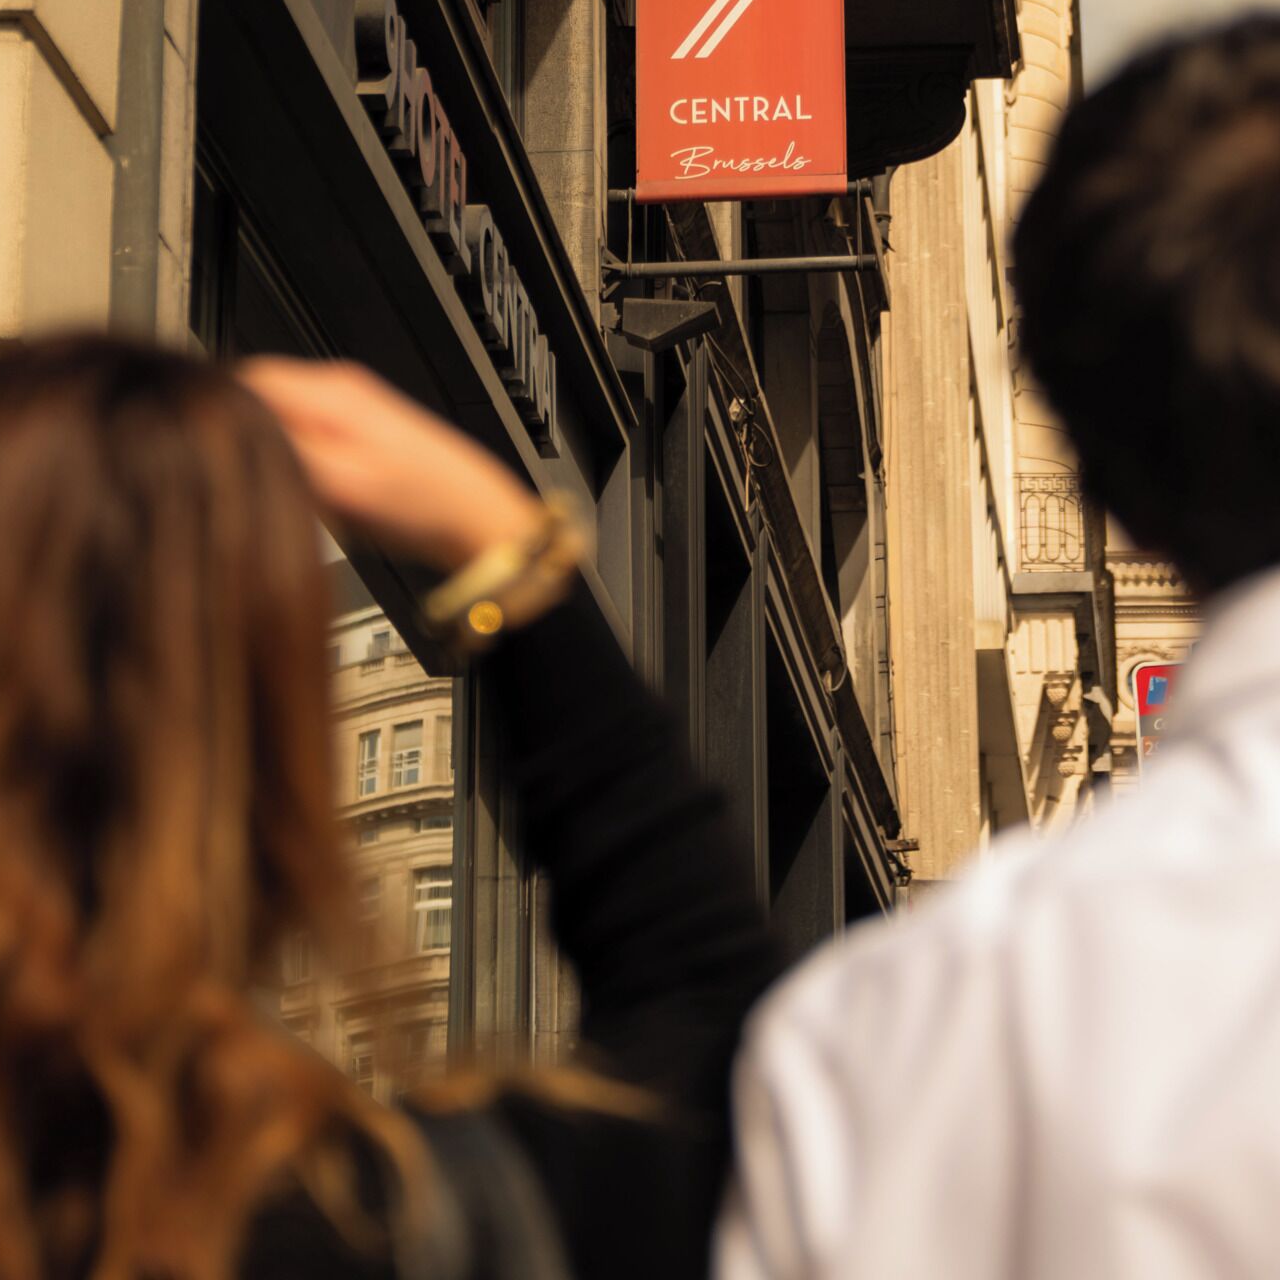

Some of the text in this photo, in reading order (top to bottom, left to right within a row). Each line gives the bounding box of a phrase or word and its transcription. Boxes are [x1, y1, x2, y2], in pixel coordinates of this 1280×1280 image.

[669, 94, 813, 125] CENTRAL
[669, 141, 813, 180] Brussels
[465, 204, 560, 459] CENTRAL
